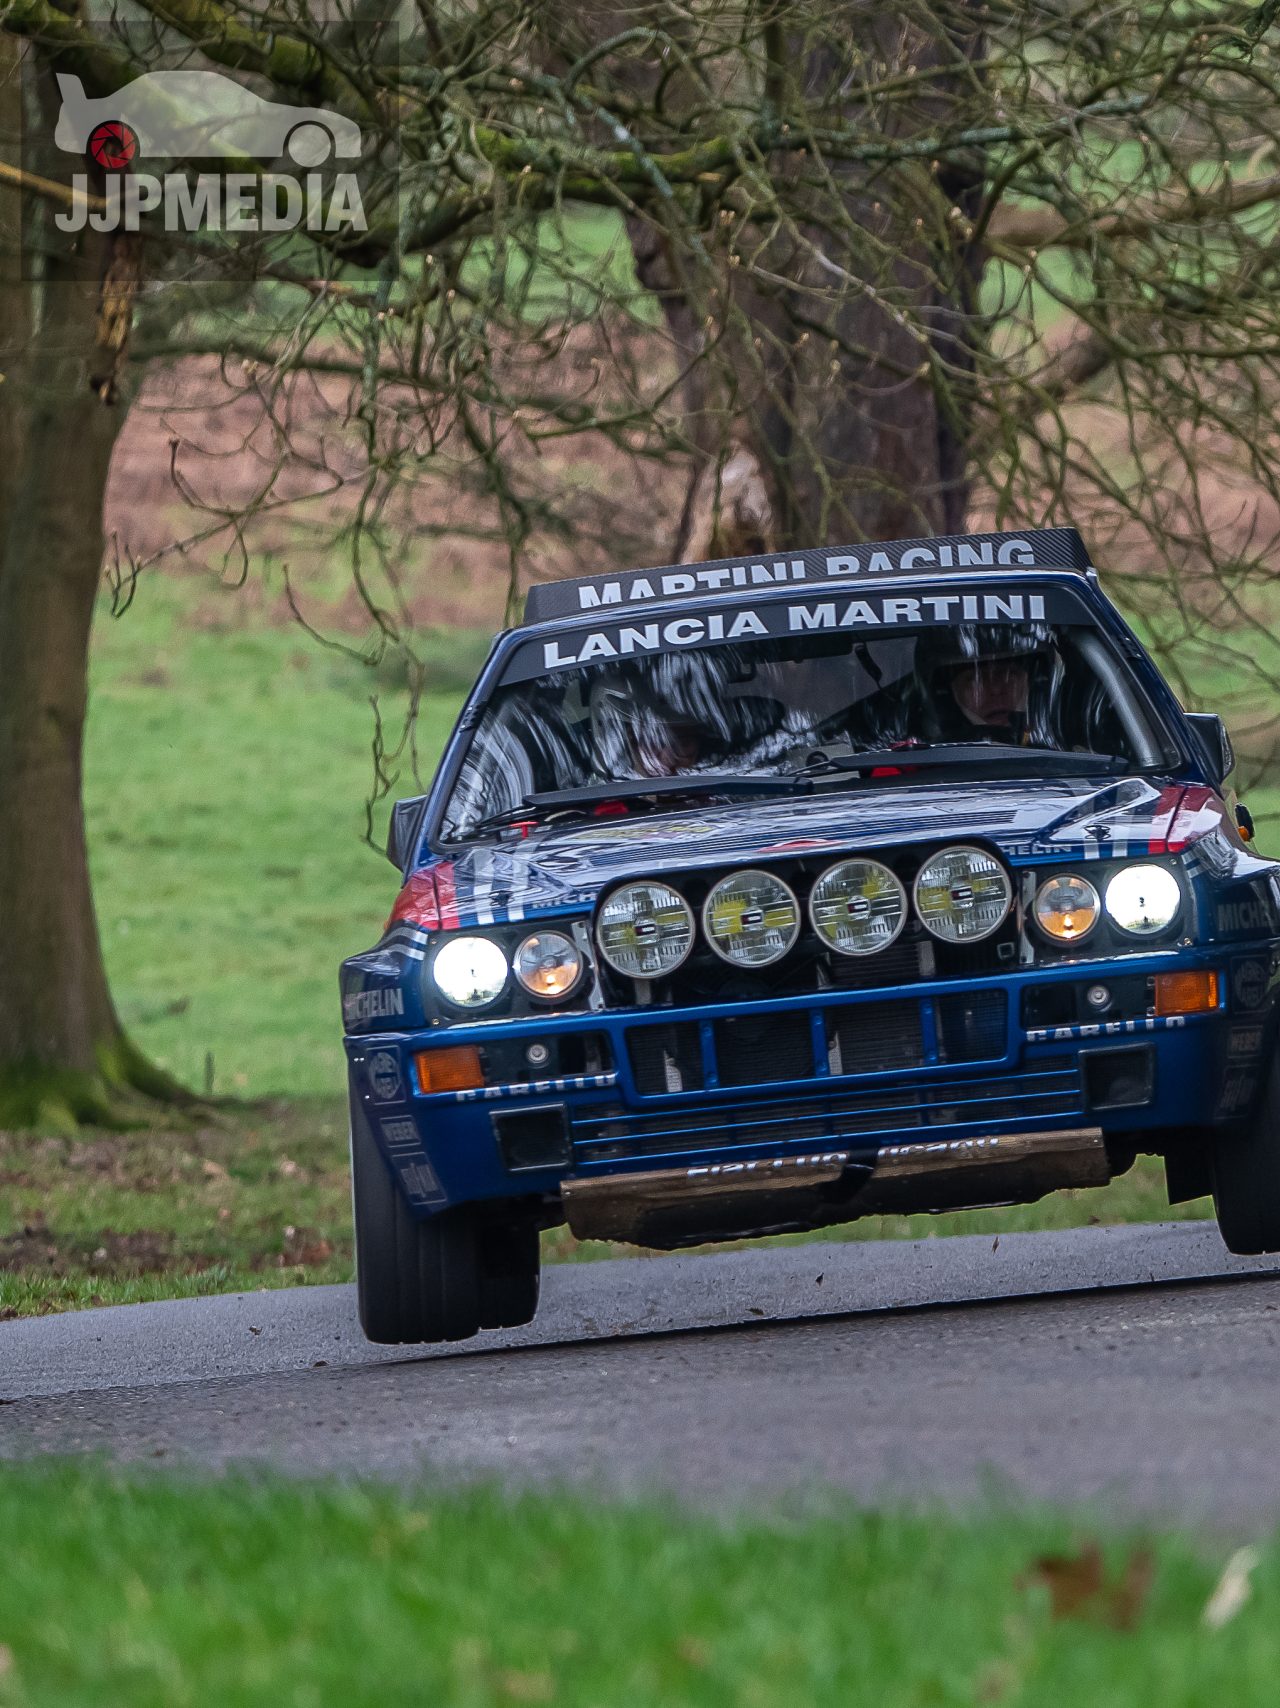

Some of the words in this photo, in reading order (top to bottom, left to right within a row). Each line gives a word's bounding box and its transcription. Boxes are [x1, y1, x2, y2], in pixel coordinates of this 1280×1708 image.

[578, 560, 806, 609] MARTINI
[826, 539, 1035, 576] RACING
[544, 611, 769, 669] LANCIA
[788, 595, 1045, 631] MARTINI
